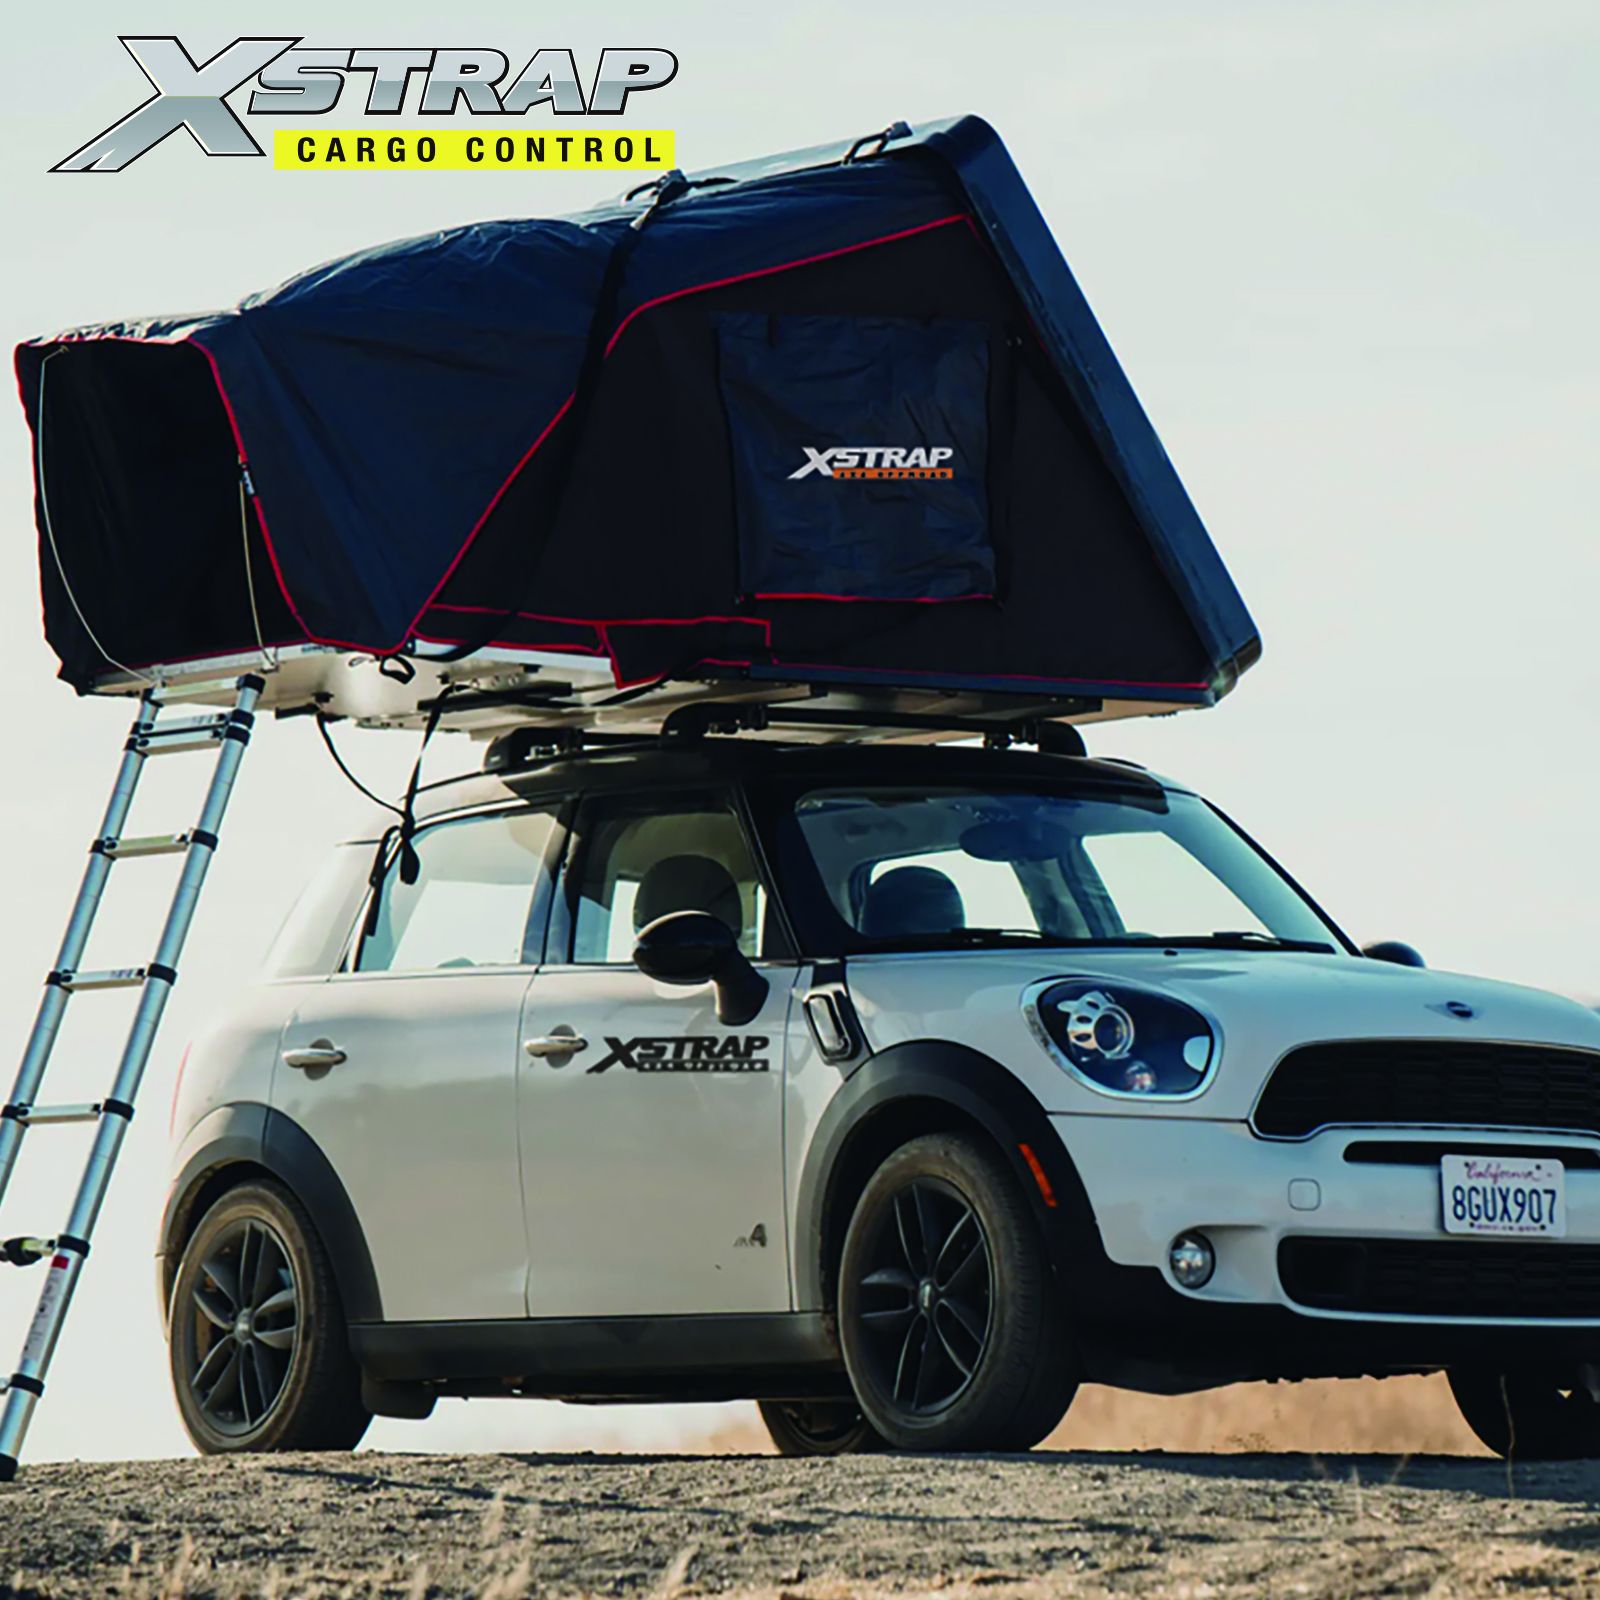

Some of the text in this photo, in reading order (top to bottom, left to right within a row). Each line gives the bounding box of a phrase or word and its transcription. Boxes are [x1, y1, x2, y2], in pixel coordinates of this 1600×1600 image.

[787, 447, 954, 479] XSTRAP
[586, 1036, 770, 1074] XSTRAP
[1452, 1185, 1557, 1224] 8GUX907
